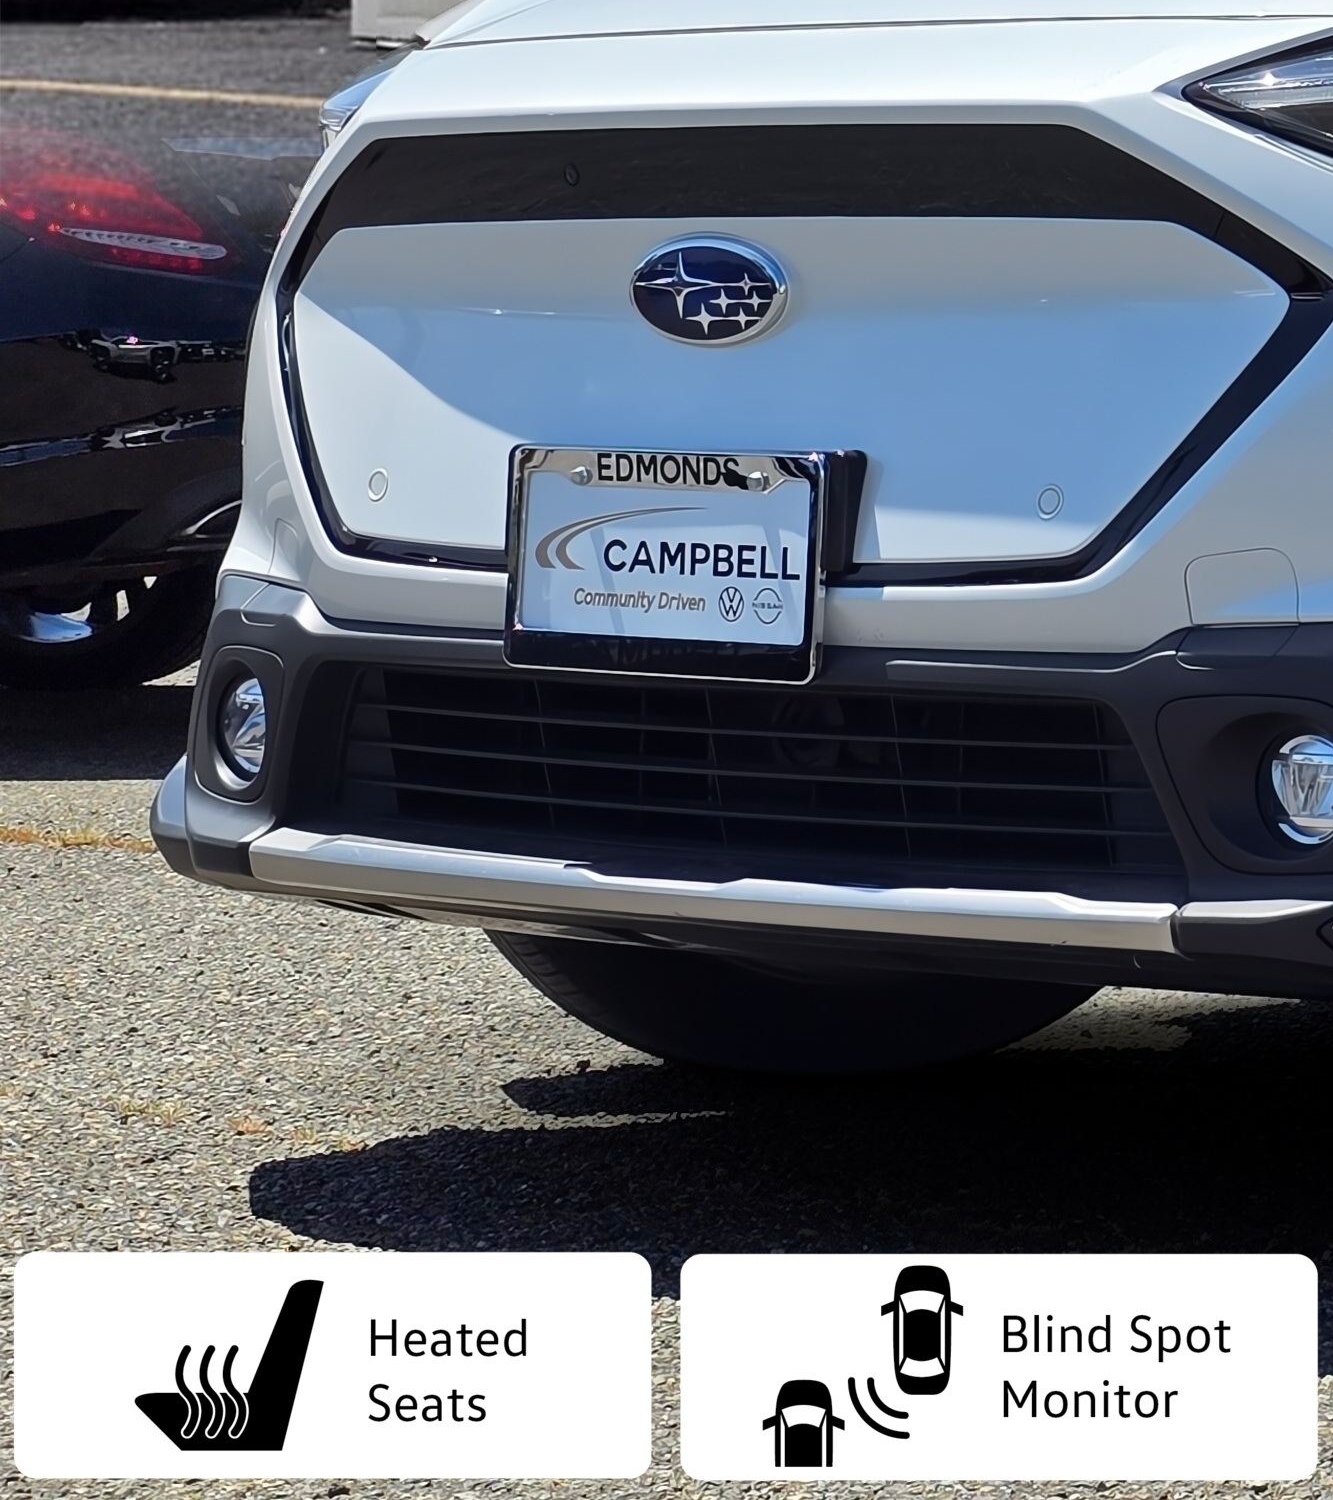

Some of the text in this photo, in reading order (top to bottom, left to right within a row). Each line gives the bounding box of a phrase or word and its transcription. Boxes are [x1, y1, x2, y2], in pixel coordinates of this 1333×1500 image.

[596, 452, 740, 486] EDMONDS
[603, 538, 801, 580] CAMPBELL
[574, 587, 706, 613] Community Driven
